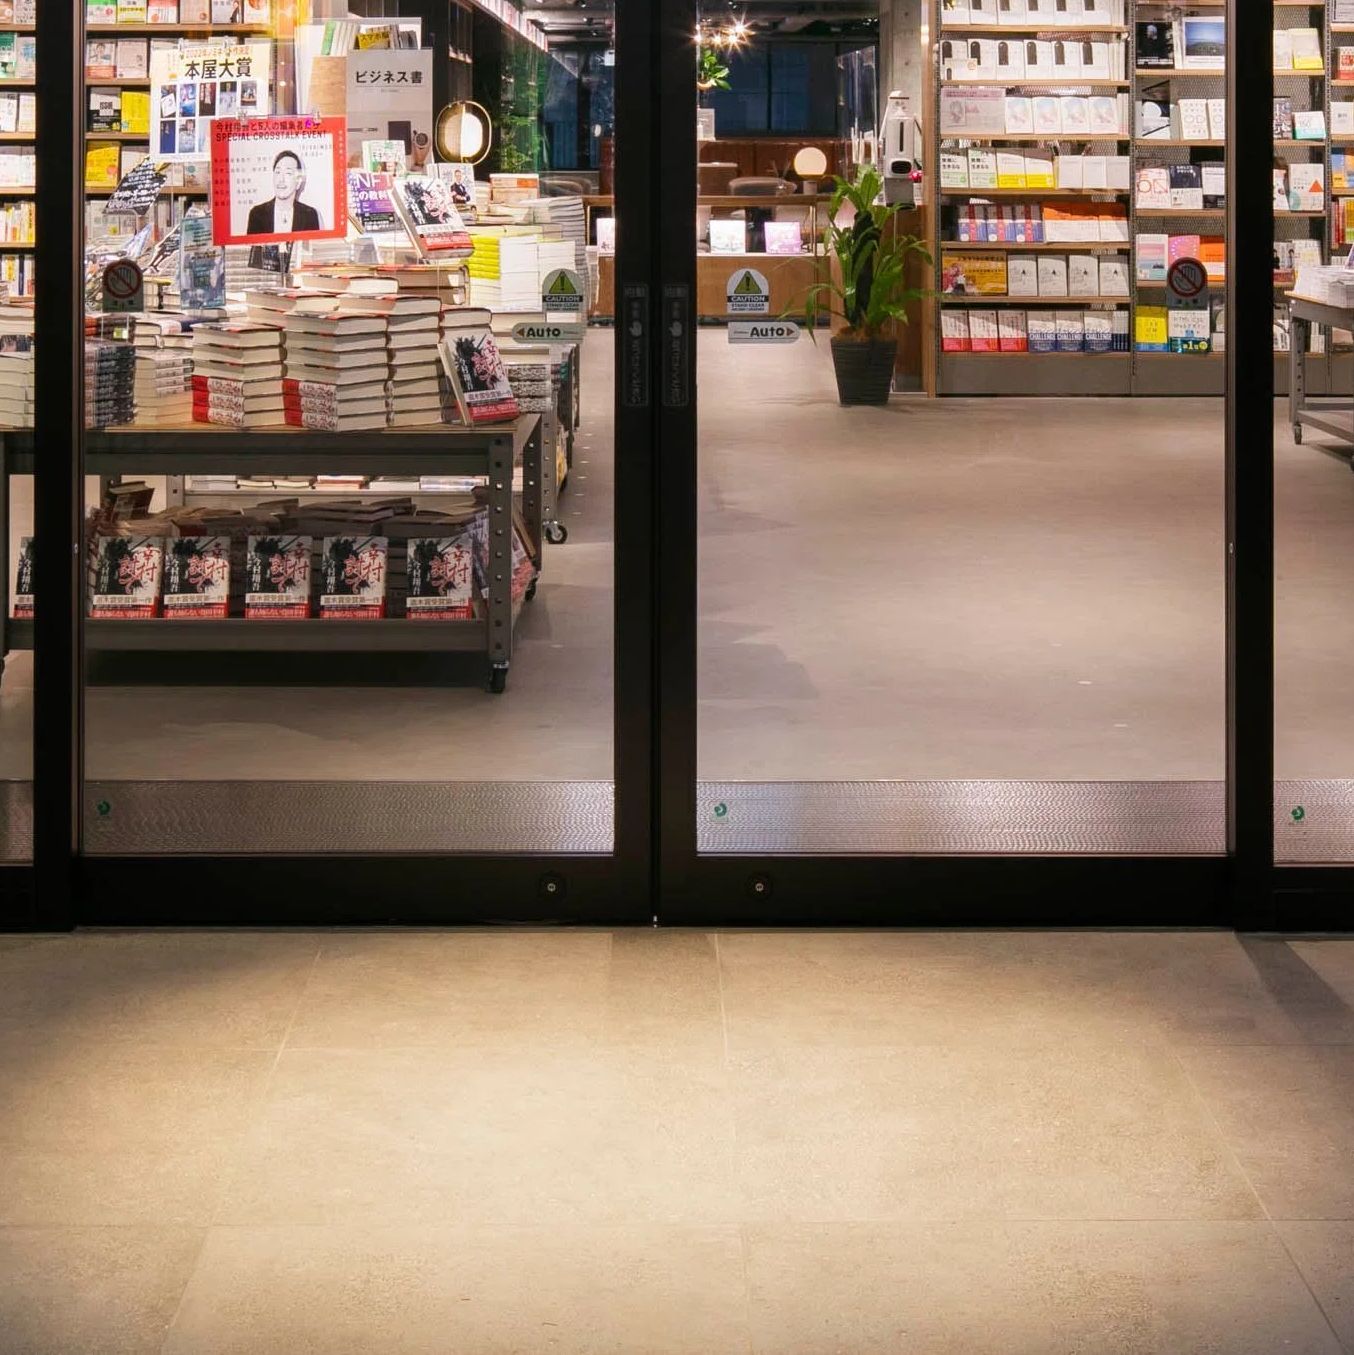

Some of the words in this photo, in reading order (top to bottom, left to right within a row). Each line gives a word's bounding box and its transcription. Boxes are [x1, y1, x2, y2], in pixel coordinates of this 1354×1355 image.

[185, 57, 253, 80] 本屋大賞
[356, 70, 423, 85] ビジネス書
[216, 132, 252, 142] SPECIAL
[356, 173, 392, 188] NFT
[526, 327, 561, 338] Auto
[750, 326, 785, 337] Auto
